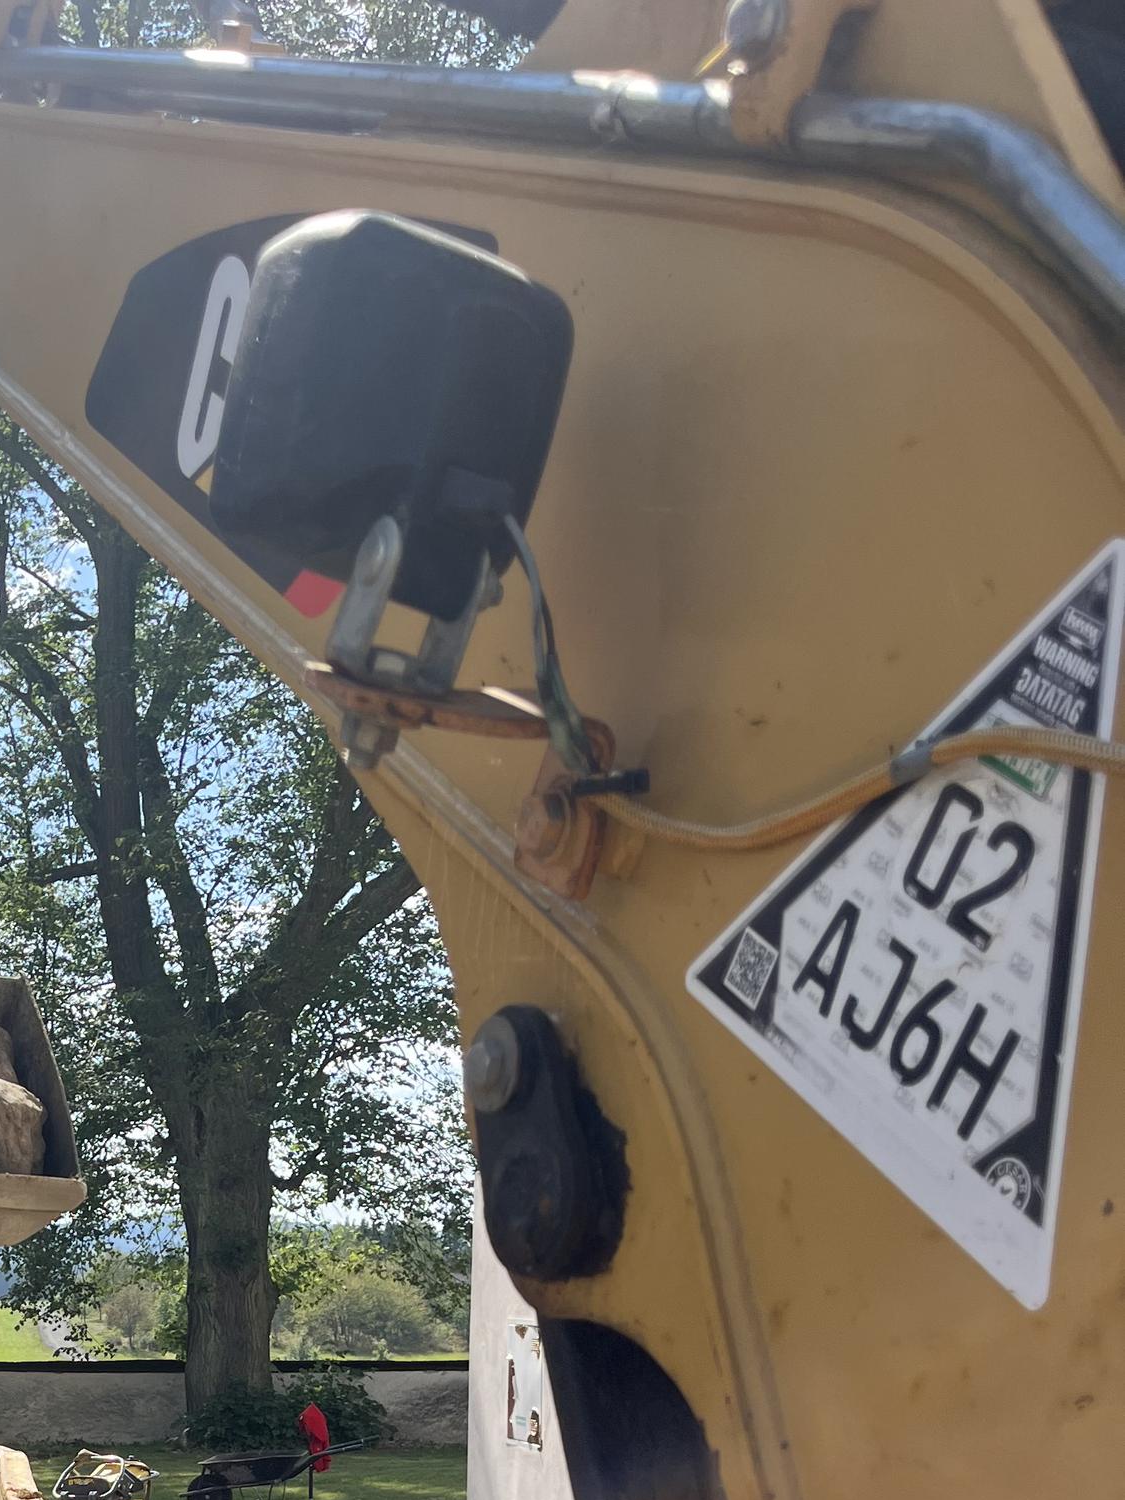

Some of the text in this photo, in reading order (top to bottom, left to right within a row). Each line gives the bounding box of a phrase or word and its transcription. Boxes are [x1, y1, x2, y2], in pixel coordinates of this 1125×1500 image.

[1033, 635, 1100, 689] WARNING
[1015, 667, 1086, 726] DATATAG
[792, 899, 1022, 1142] AJ6H
